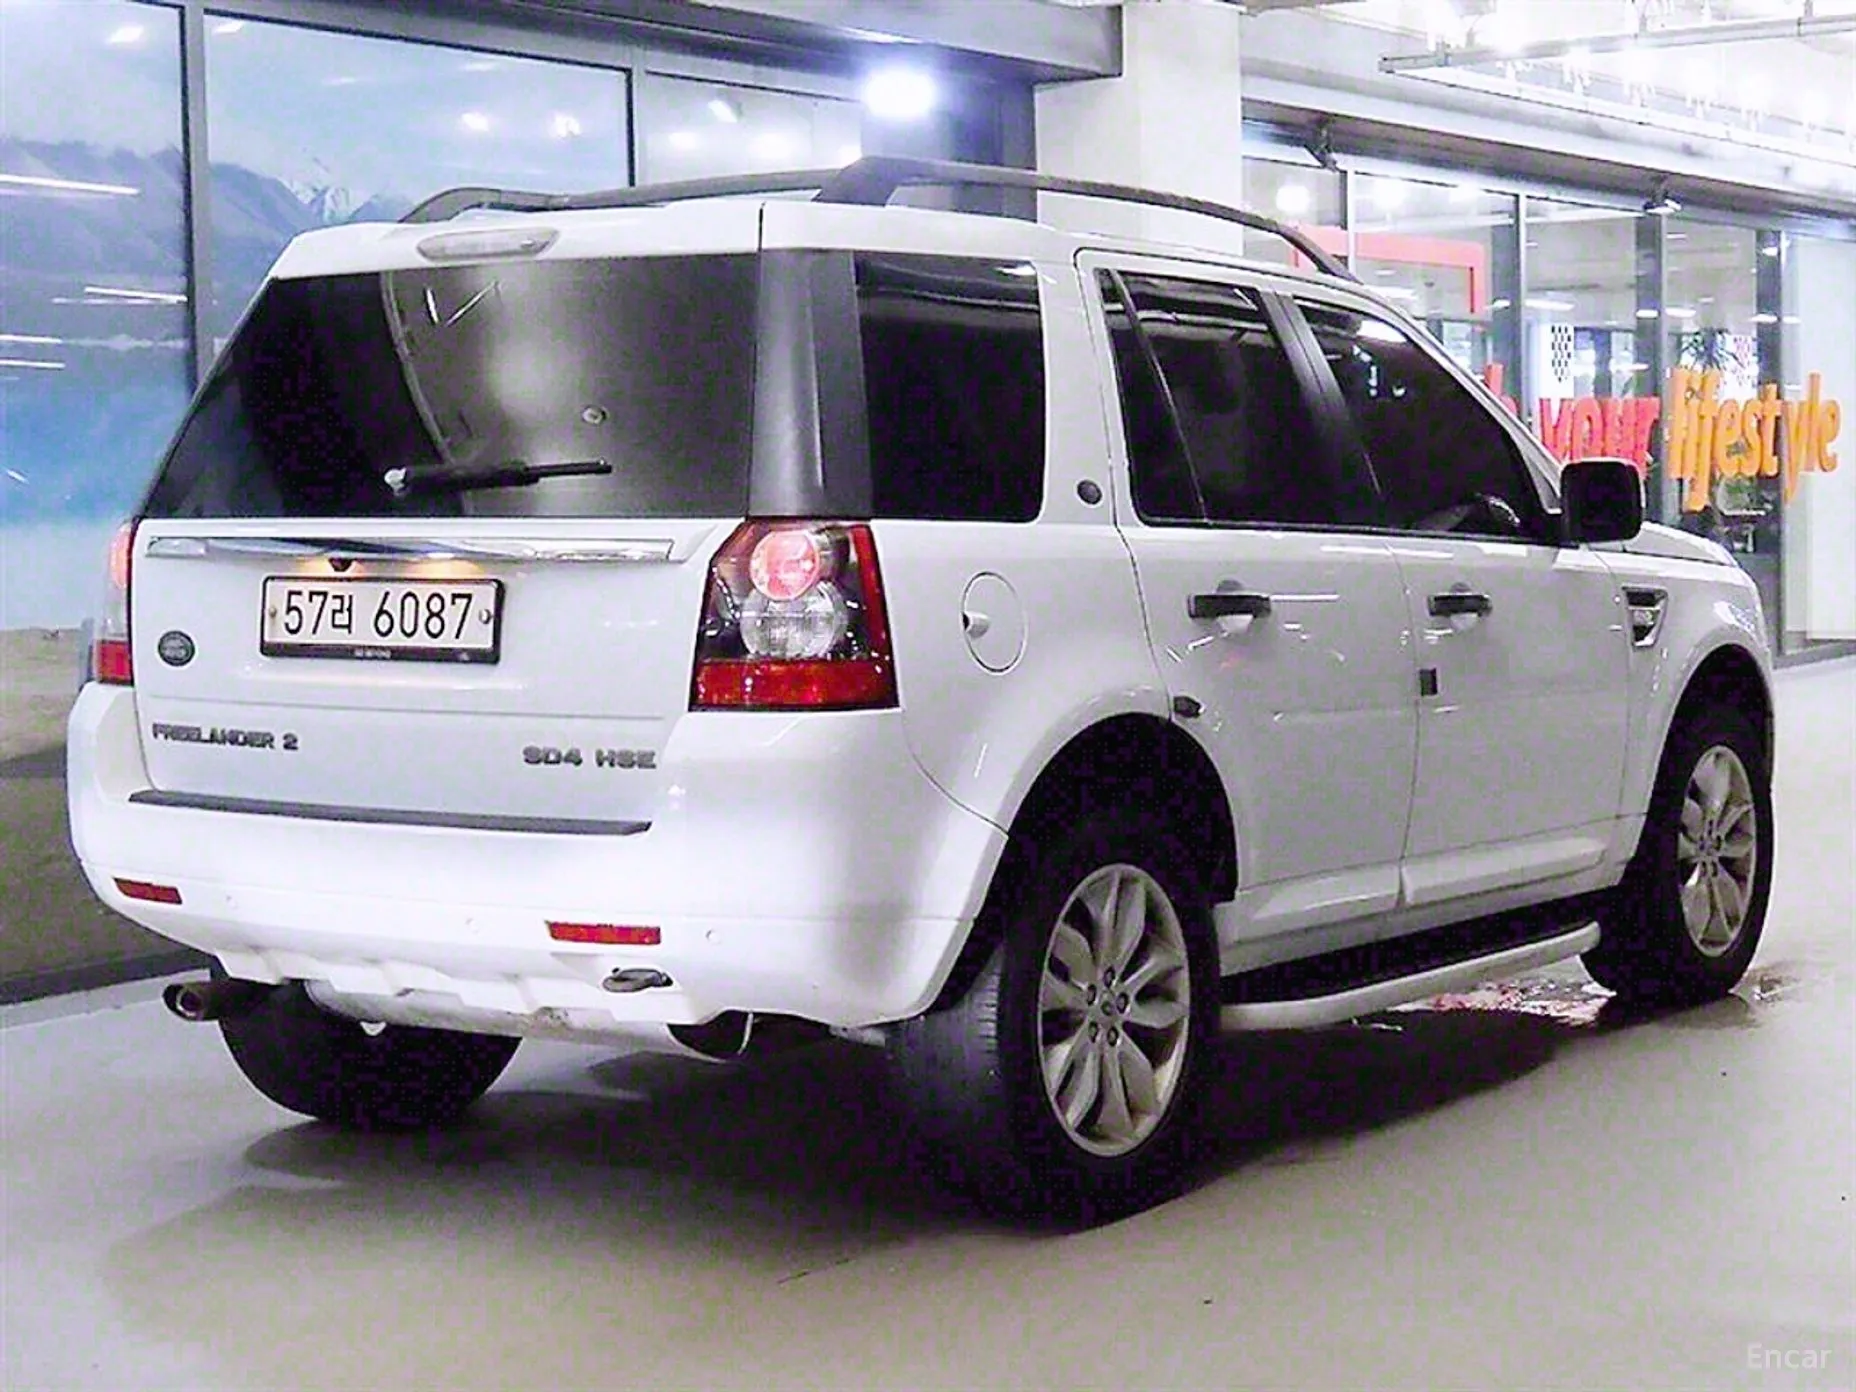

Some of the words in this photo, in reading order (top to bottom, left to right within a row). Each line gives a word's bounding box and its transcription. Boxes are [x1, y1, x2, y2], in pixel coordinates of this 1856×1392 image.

[1666, 367, 1842, 513] lifestyle
[373, 590, 473, 640] 6087
[152, 722, 274, 749] FREELANDER
[282, 732, 299, 751] 2
[523, 745, 583, 766] SD4
[595, 748, 657, 769] HSE
